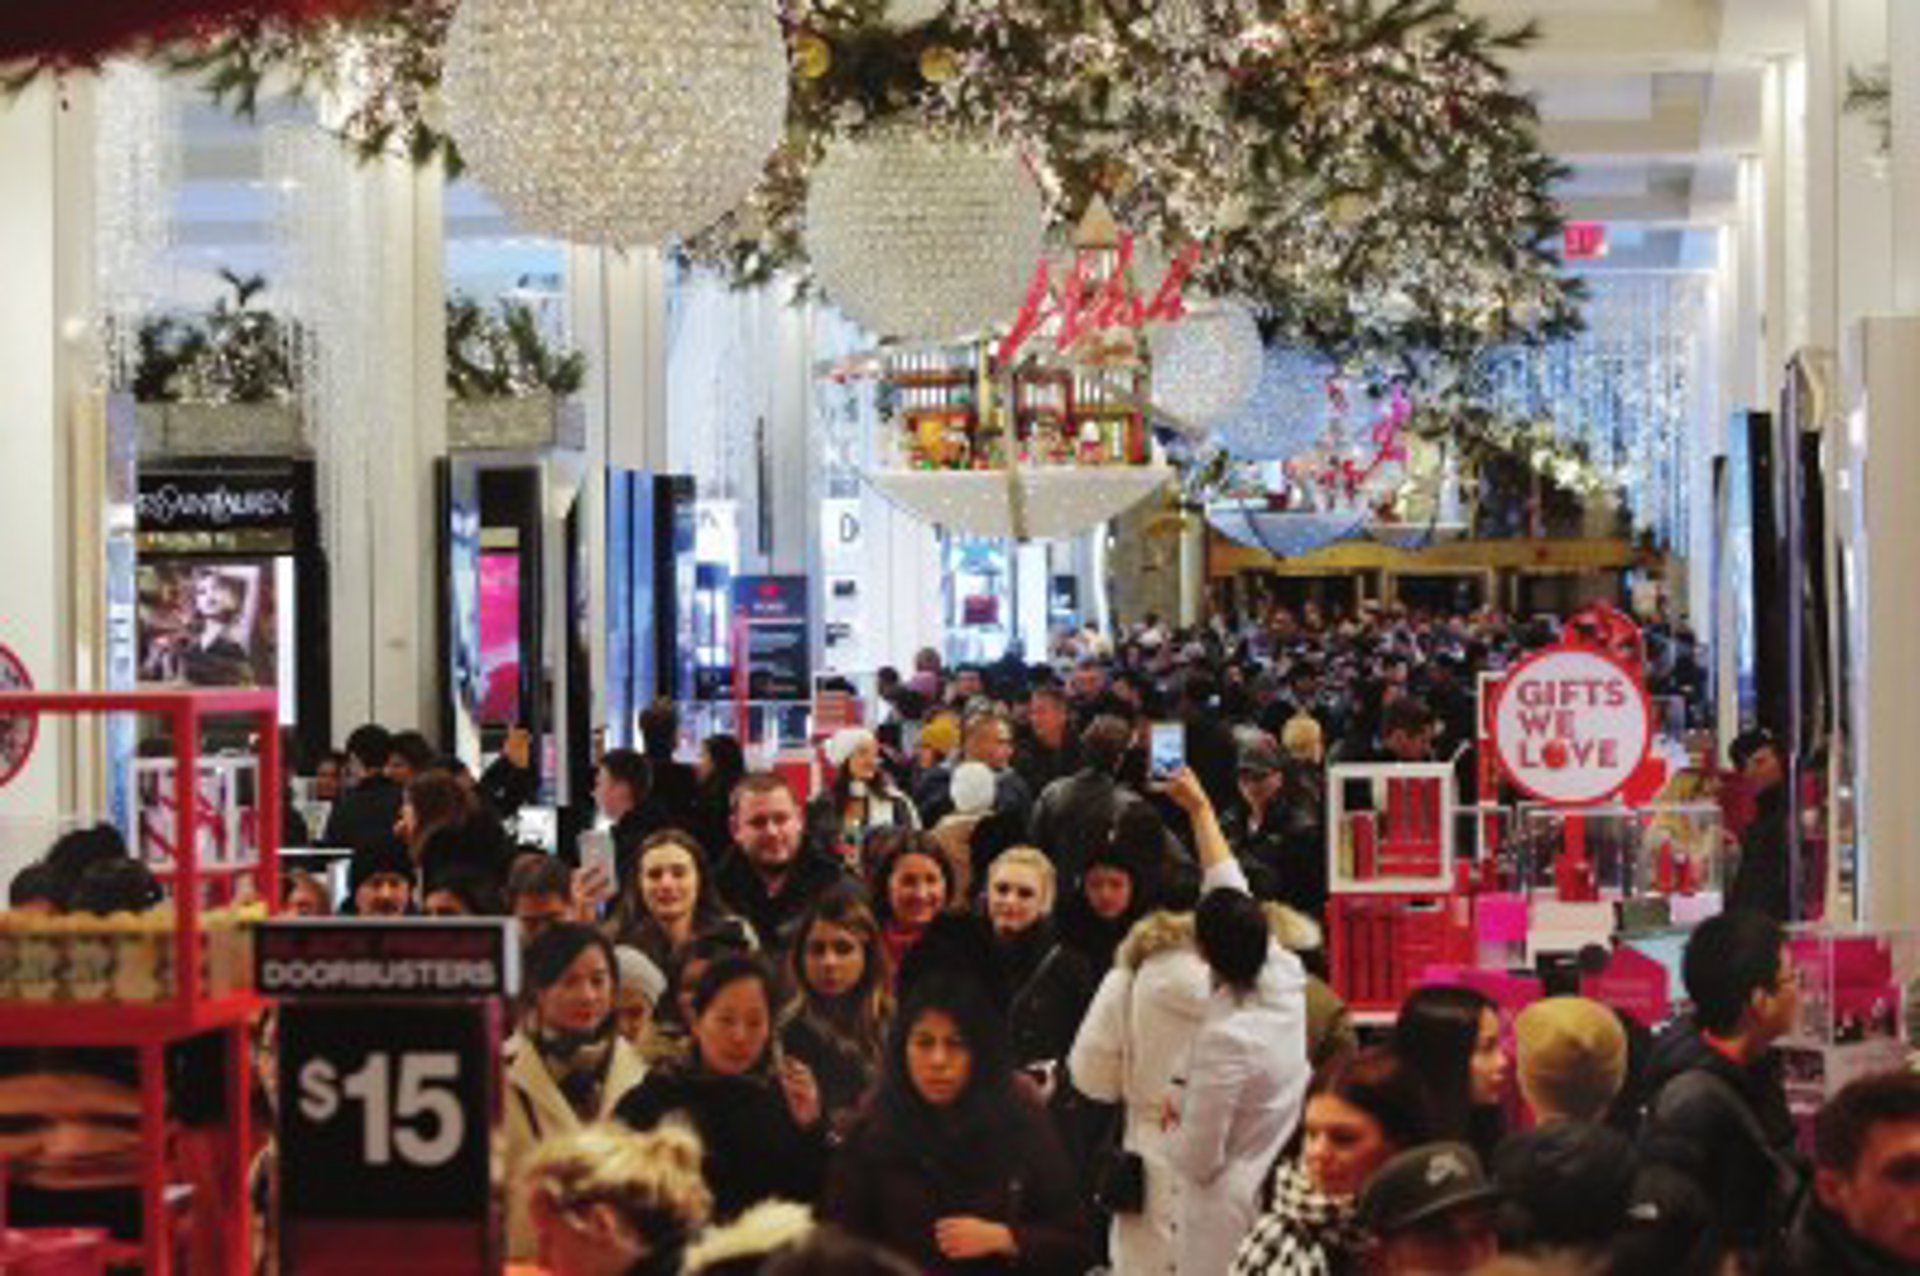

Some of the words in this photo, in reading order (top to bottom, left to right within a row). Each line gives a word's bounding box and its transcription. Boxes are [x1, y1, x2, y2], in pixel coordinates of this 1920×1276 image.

[1516, 679, 1625, 707] GIFTS
[1516, 709, 1575, 738] WE
[1517, 738, 1618, 771] LOVE
[263, 959, 496, 987] DOORBUSTERS
[300, 1053, 464, 1166] $15
